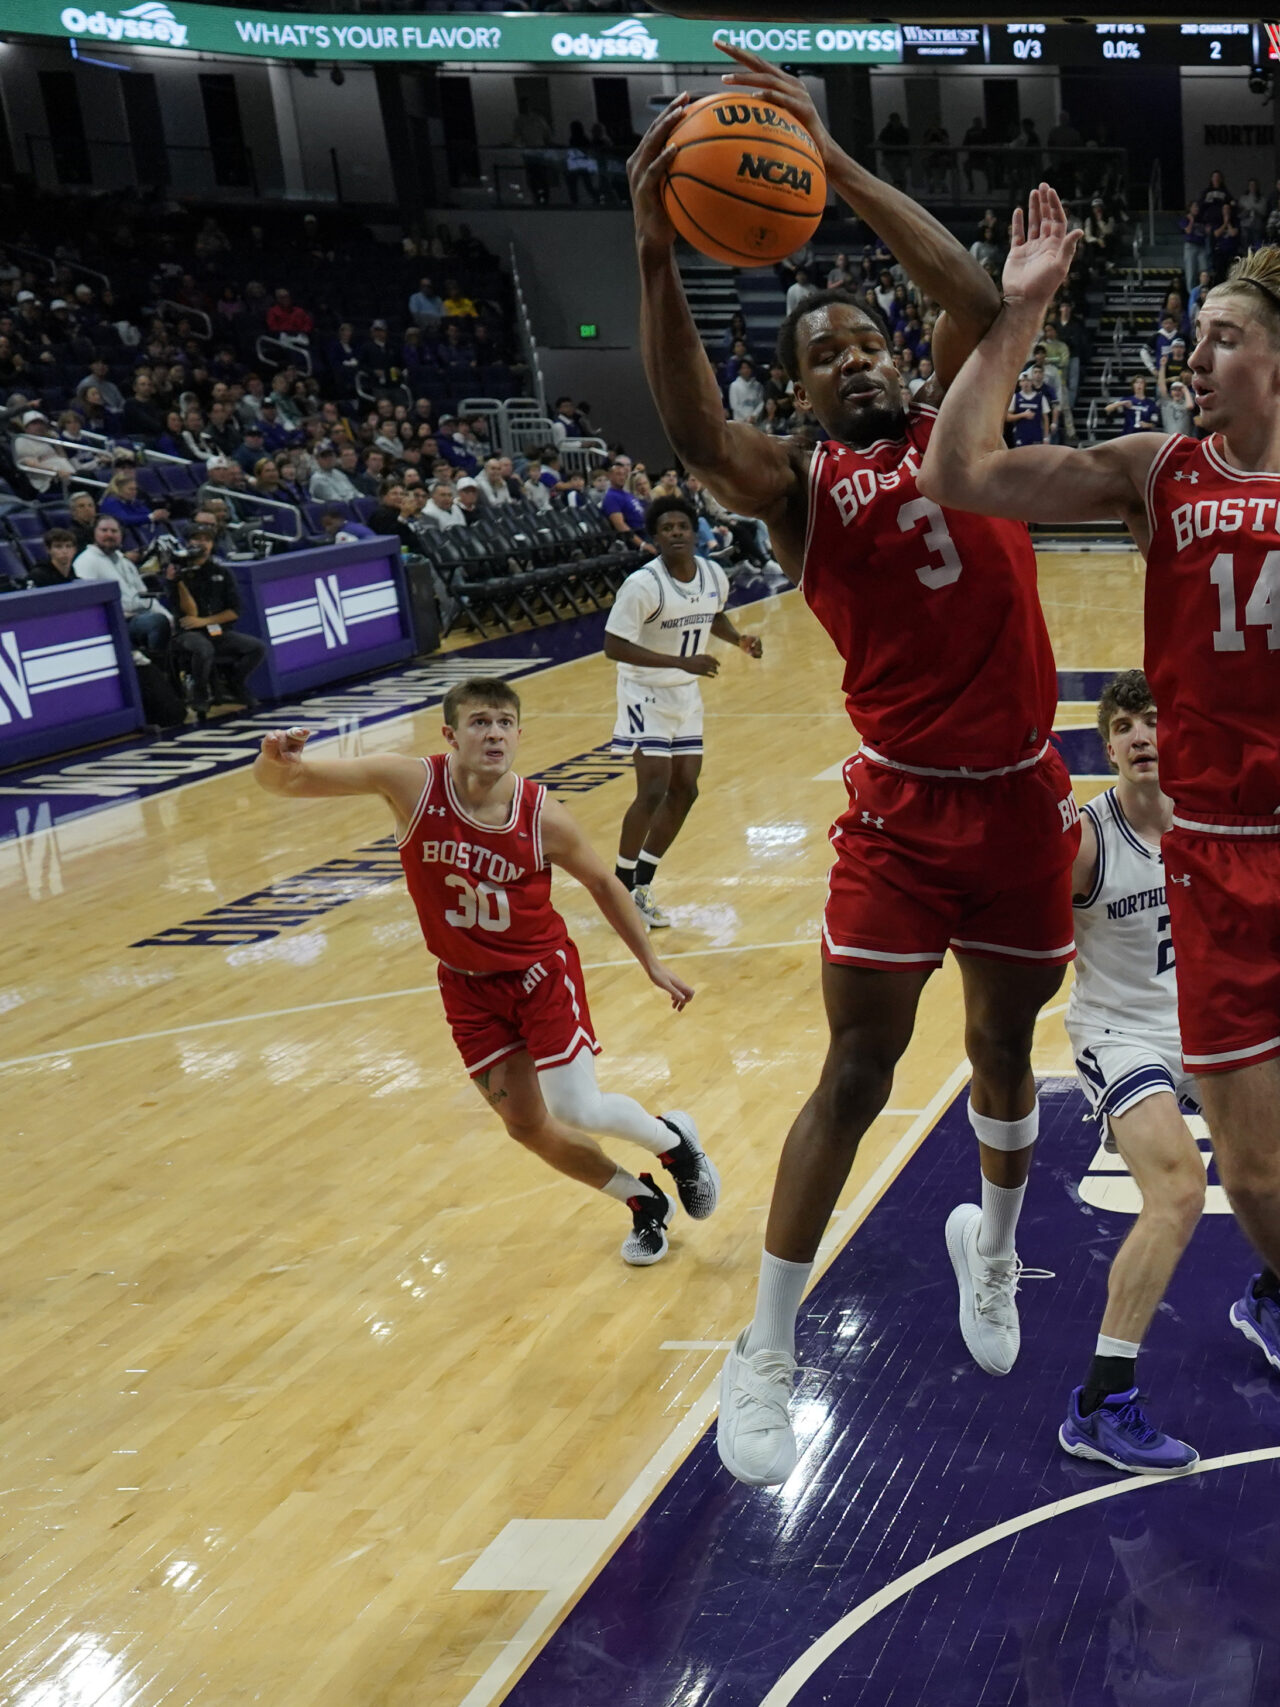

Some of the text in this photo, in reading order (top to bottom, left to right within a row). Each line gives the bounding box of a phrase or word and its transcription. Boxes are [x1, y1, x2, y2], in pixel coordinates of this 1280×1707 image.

[61, 7, 188, 46] Odyssey
[235, 20, 501, 49] WHAT'S YOUR FLAVOR?
[712, 29, 812, 51] CHOOSE
[903, 26, 979, 41] WINTRUST
[551, 32, 658, 60] Odyssey
[1013, 40, 1042, 59] 0/3
[1102, 40, 1141, 59] 0.0%
[1210, 41, 1222, 59] 2
[713, 104, 816, 152] Wilson
[737, 152, 812, 195] NCAA
[830, 447, 922, 527] BOST
[897, 496, 963, 590] 3
[315, 575, 349, 649] N
[680, 629, 702, 657] 11
[627, 704, 645, 734] N
[422, 840, 525, 882] BOSTON
[444, 873, 511, 932] 30
[522, 962, 549, 994] BU
